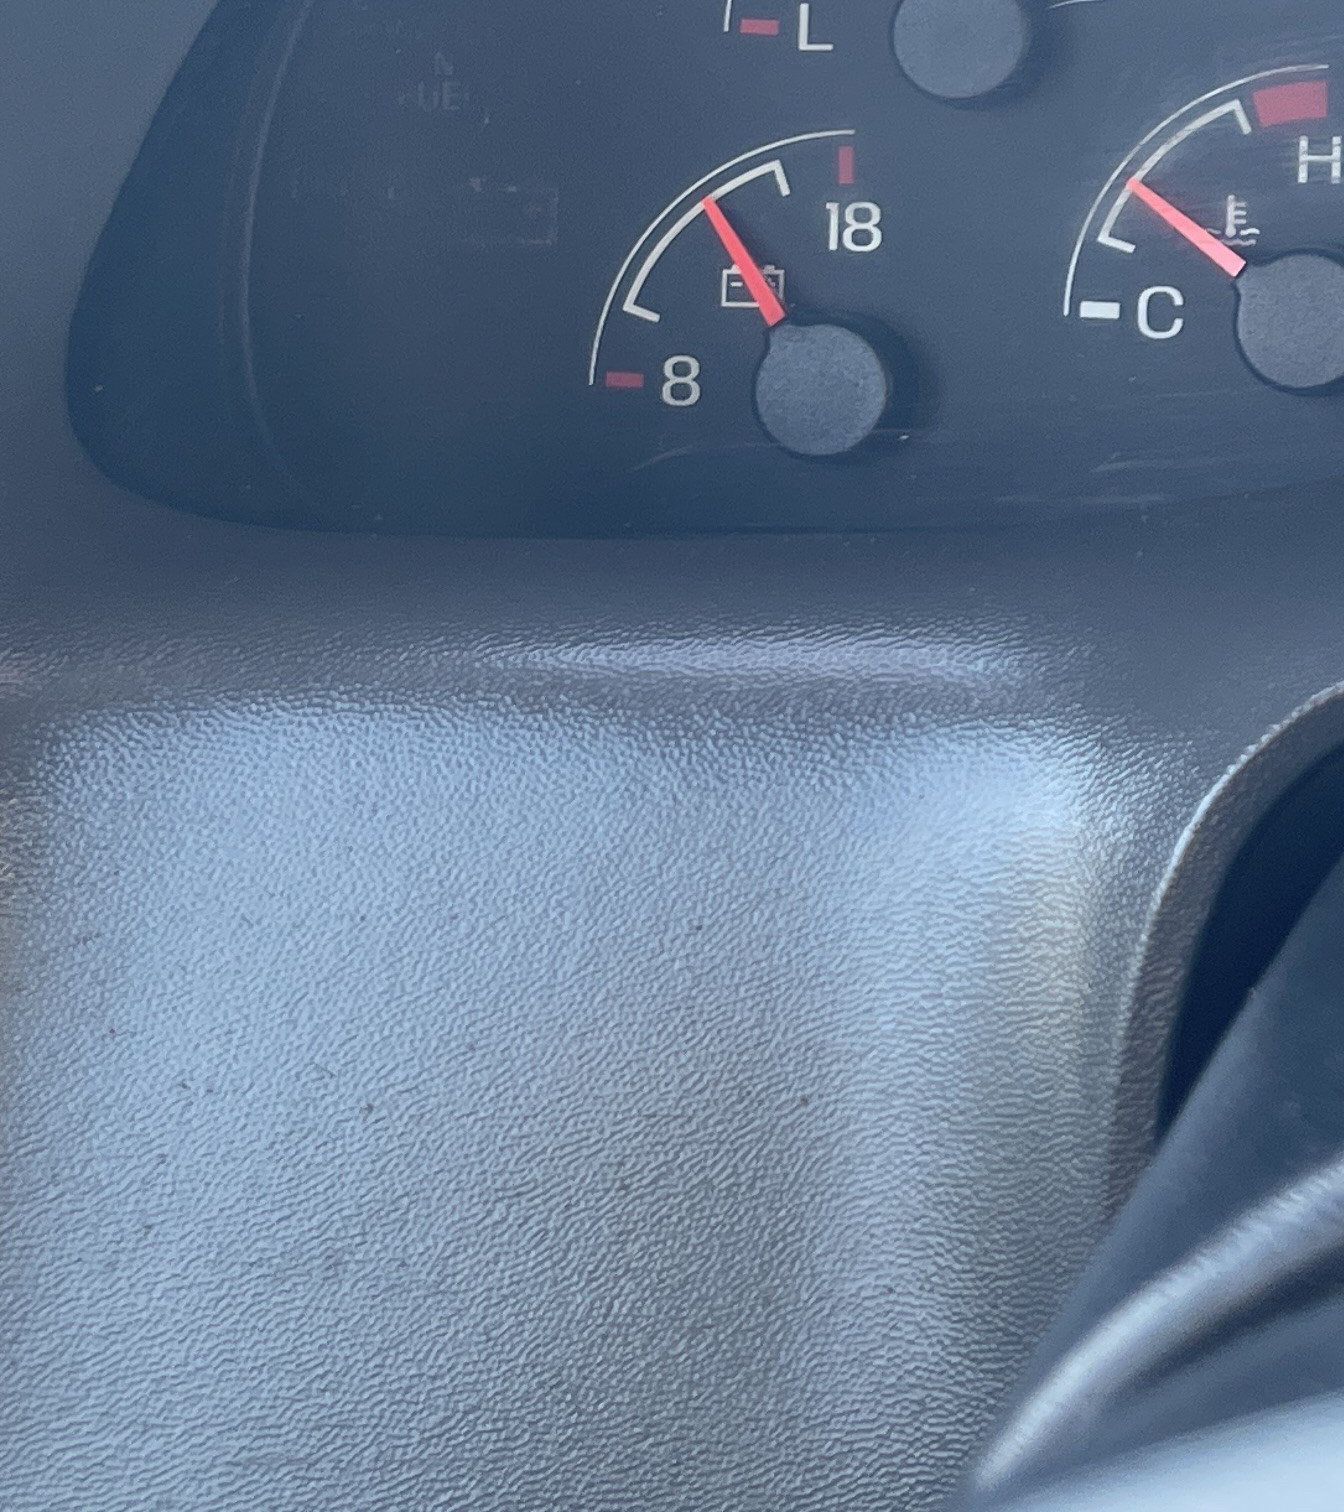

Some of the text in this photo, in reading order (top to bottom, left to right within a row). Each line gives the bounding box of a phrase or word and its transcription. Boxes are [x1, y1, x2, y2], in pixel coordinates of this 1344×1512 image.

[798, 2, 834, 51] L
[1297, 135, 1342, 184] H
[825, 202, 882, 252] 18
[1137, 285, 1184, 339] C
[662, 355, 700, 406] 8
